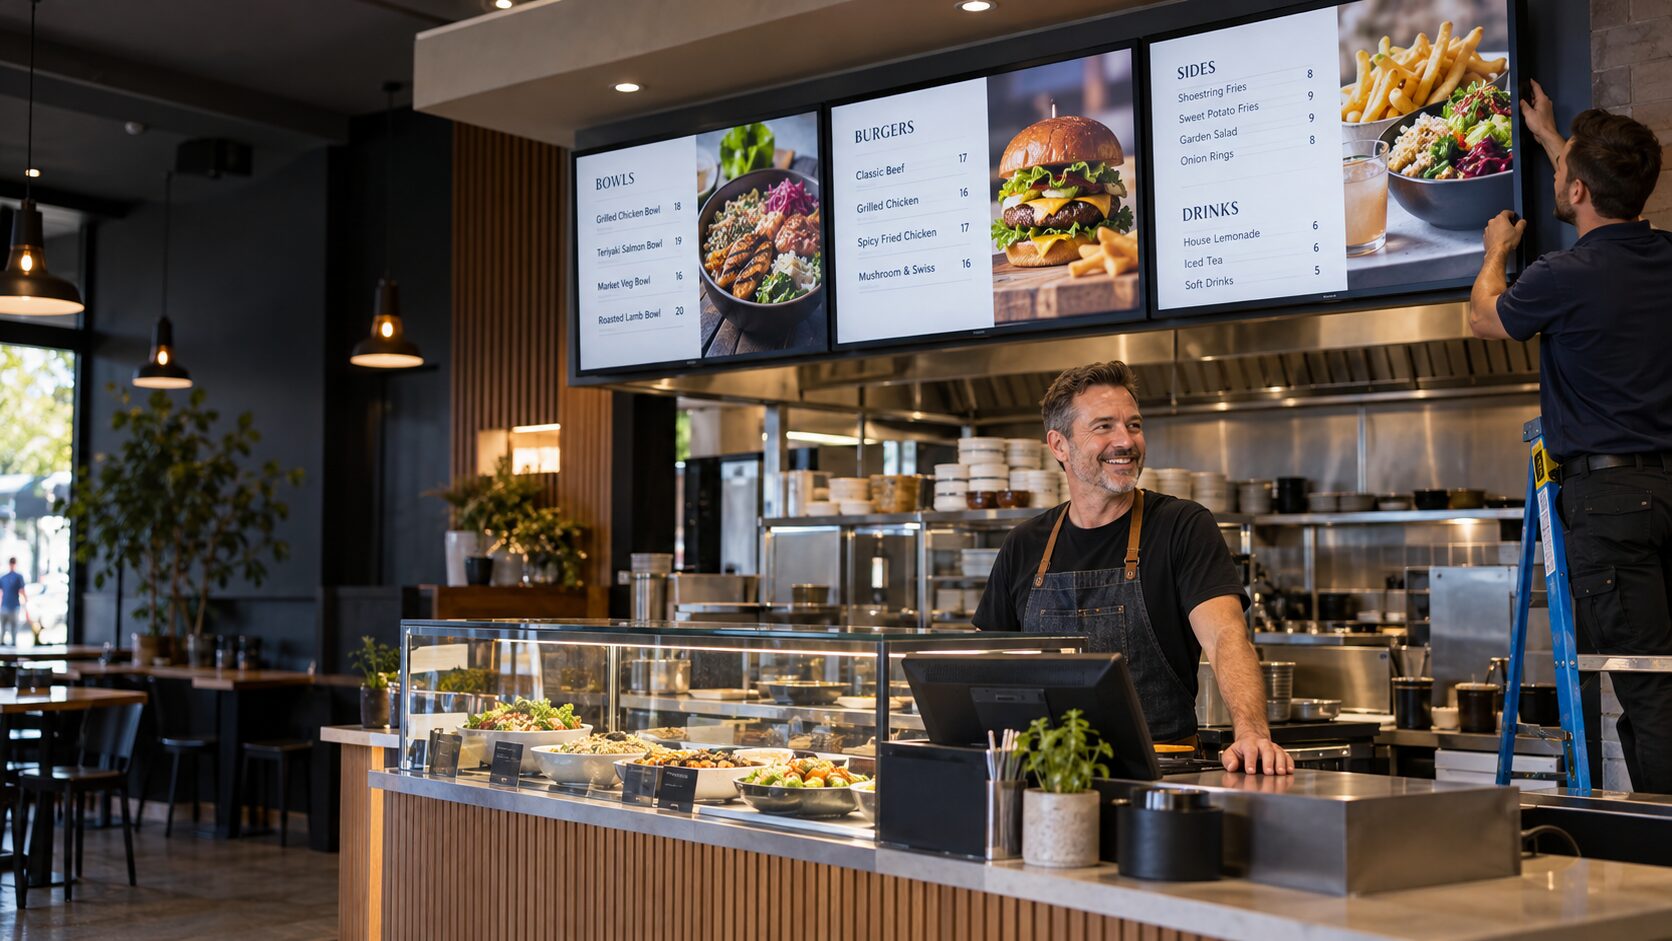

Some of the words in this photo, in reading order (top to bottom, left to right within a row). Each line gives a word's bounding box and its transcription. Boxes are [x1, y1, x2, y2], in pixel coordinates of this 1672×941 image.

[1177, 60, 1216, 80] SIDES
[1178, 88, 1223, 103] Shoestring
[1226, 83, 1247, 94] Fries
[1307, 69, 1313, 79] 8
[1179, 112, 1205, 124] Sweet
[1207, 107, 1235, 118] Potato
[1238, 103, 1259, 113] Fries
[1308, 91, 1314, 101] 9
[855, 120, 914, 144] BURGERS
[1180, 133, 1211, 144] Garden
[1214, 127, 1238, 139] Salad
[1309, 113, 1315, 123] 9
[1180, 154, 1207, 166] Onion
[1210, 151, 1234, 162] Rings
[1309, 135, 1315, 145] 8
[856, 168, 884, 180] Classic
[886, 163, 905, 175] Beef
[959, 153, 967, 163] 17
[596, 172, 635, 190] BOWLS
[596, 212, 617, 224] Grilled
[618, 210, 643, 220] Chicken
[645, 205, 660, 216] Bowl
[674, 202, 681, 211] 18
[857, 201, 883, 214] Grilled
[886, 197, 919, 209] Chicken
[960, 187, 968, 197] 16
[1183, 201, 1239, 222] DRINKS
[858, 237, 879, 249] Spicy
[881, 232, 902, 244] Fried
[904, 229, 937, 241] Chicken
[961, 222, 969, 232] 17
[1184, 237, 1211, 246] House
[1214, 229, 1260, 243] Lemonade
[1312, 220, 1319, 230] 6
[597, 246, 620, 258] Teriyaki
[622, 244, 645, 253] Salmon
[647, 239, 663, 250] Bowl
[675, 236, 682, 245] 19
[1185, 257, 1203, 268] Iced
[1206, 256, 1223, 265] Tea
[1313, 242, 1319, 253] 6
[598, 281, 620, 290] Market
[621, 279, 633, 289] Veg
[635, 276, 650, 286] Bowl
[676, 271, 683, 280] 16
[859, 269, 901, 281] Mushroom
[903, 265, 910, 276] &
[912, 264, 935, 274] Swiss
[962, 258, 971, 268] 16
[1185, 279, 1203, 290] Soft
[1206, 276, 1234, 288] Drinks
[1314, 265, 1320, 275] 5
[598, 314, 624, 324] Roasted
[625, 311, 643, 321] Lamb
[645, 308, 661, 319] Bowl
[675, 306, 684, 316] 20
